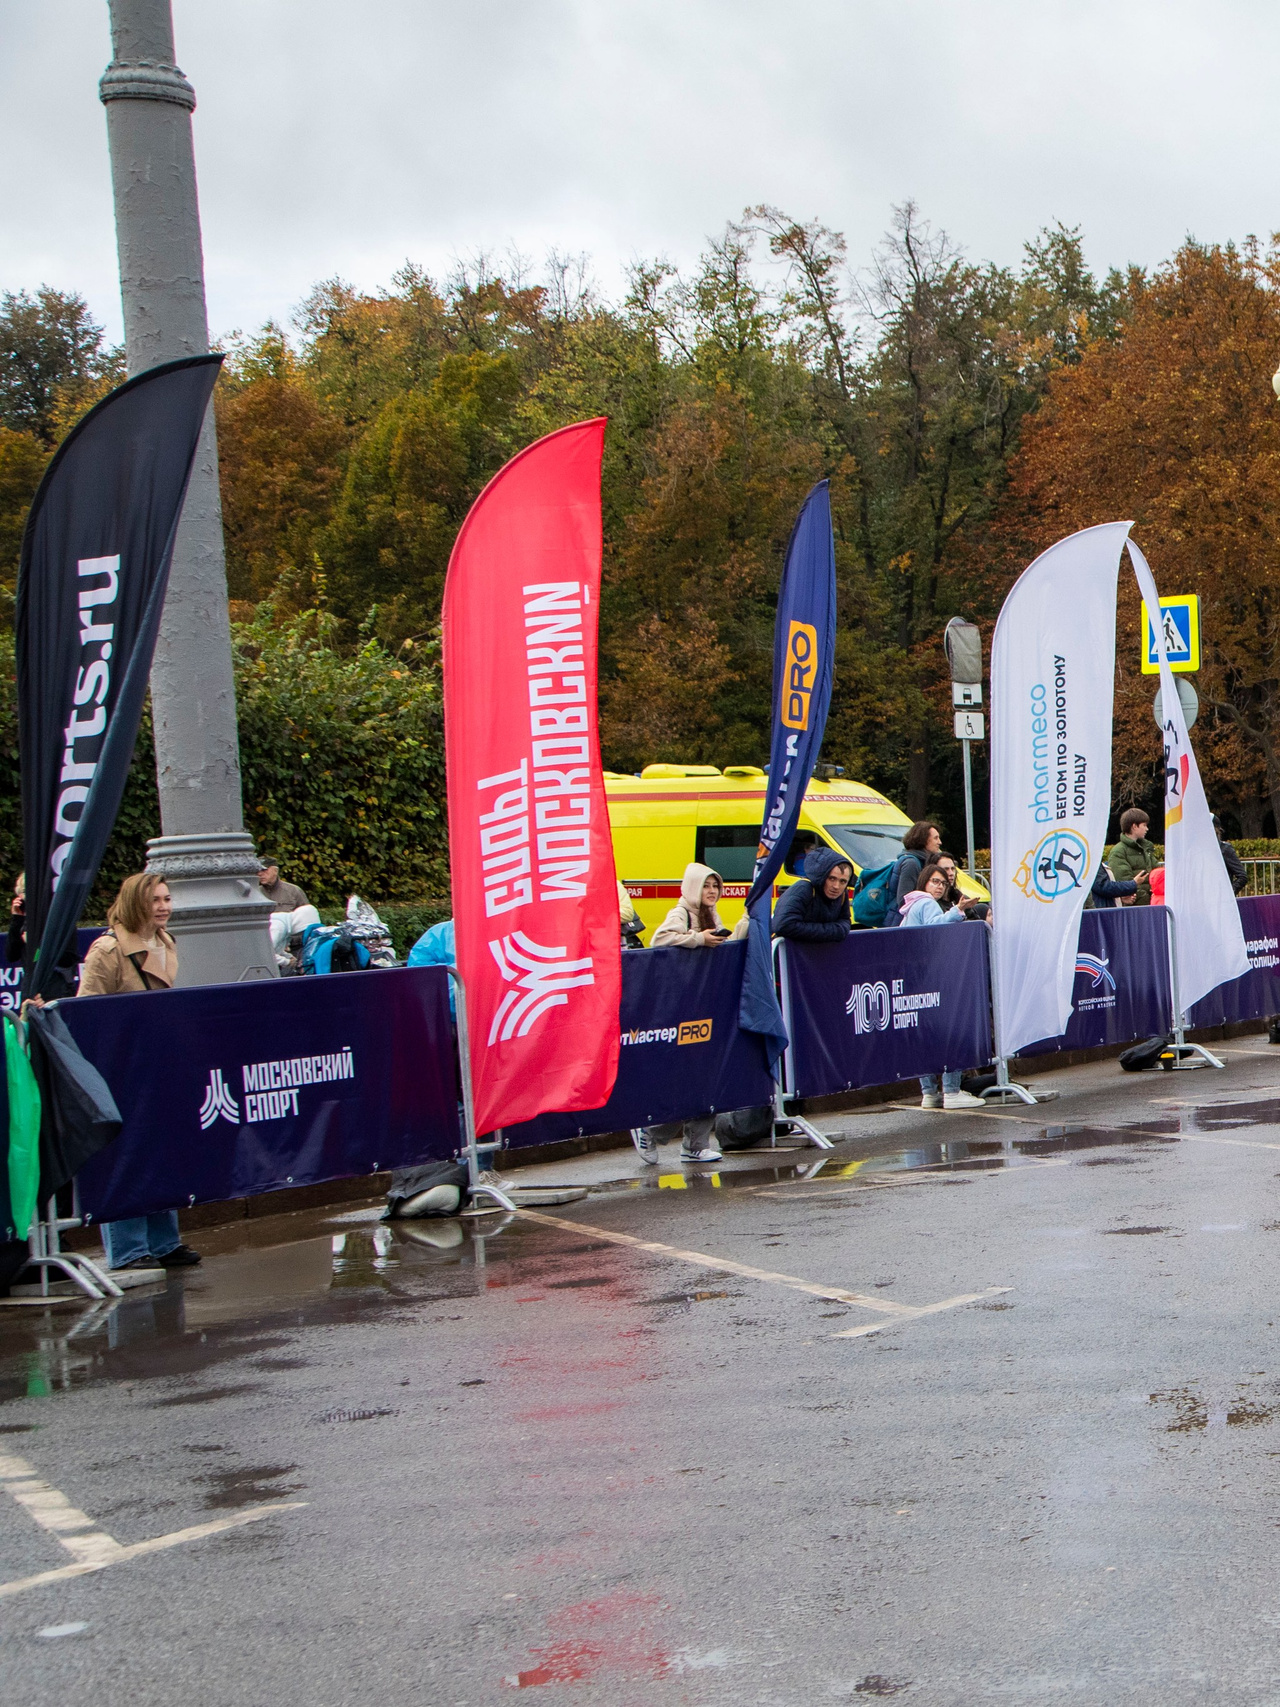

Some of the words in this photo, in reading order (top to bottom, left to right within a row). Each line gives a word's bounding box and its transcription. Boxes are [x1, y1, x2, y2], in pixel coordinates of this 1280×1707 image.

[1054, 655, 1067, 739] ЗОЛОТОМУ
[1028, 683, 1053, 823] pharmeco
[1057, 743, 1067, 766] ПО
[1056, 770, 1067, 820] БЕГОМ
[1073, 754, 1087, 817] КОЛЬЦУ
[892, 979, 904, 995] ЛЕТ
[892, 991, 941, 1012] МОСКОВСКОМУ
[680, 1023, 710, 1041] PRO
[893, 1011, 919, 1029] СПОРТУ
[242, 1046, 355, 1093] МОСКОВСКИЙ
[245, 1088, 300, 1123] СПОРТ
